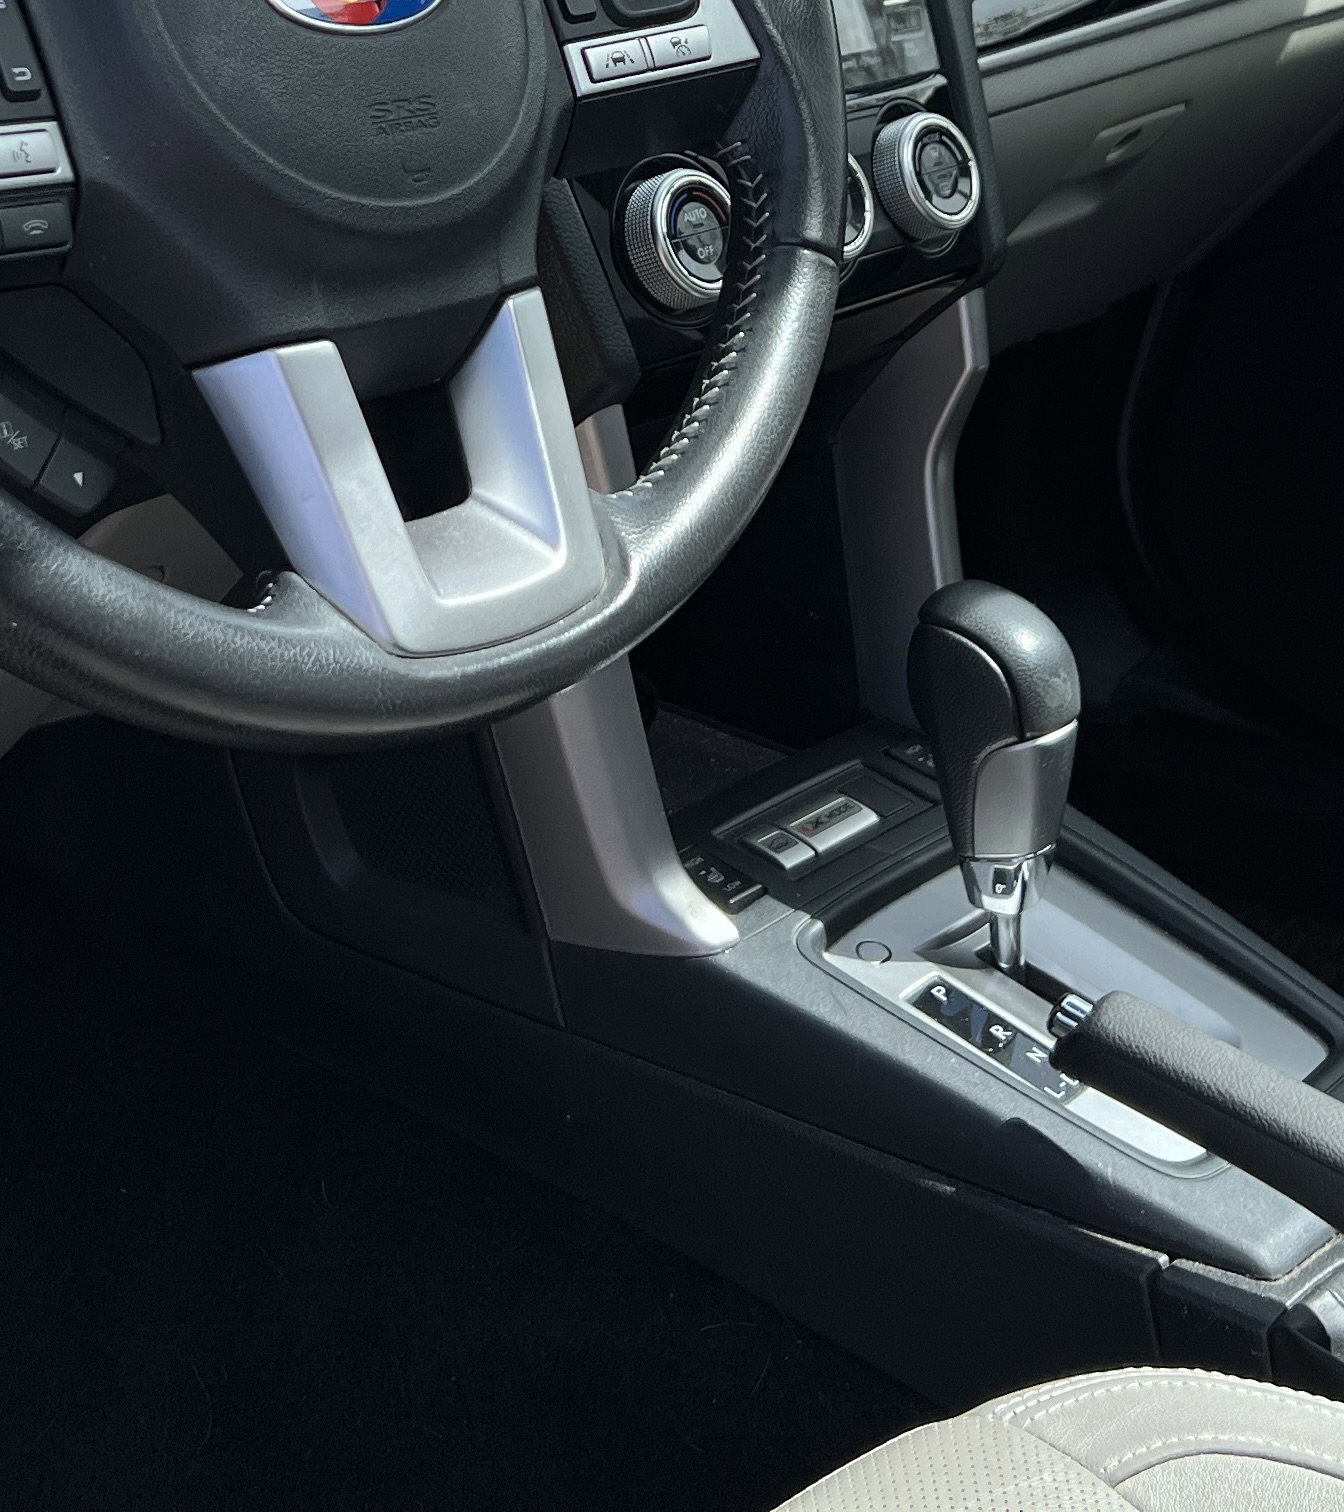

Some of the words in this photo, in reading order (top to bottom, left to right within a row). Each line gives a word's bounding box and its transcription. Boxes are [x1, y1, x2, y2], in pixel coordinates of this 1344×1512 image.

[367, 94, 437, 119] SRS
[683, 207, 708, 223] AUTO
[697, 244, 715, 259] OFF
[930, 985, 948, 1002] P
[988, 1024, 1012, 1041] R
[1025, 1046, 1049, 1064] N
